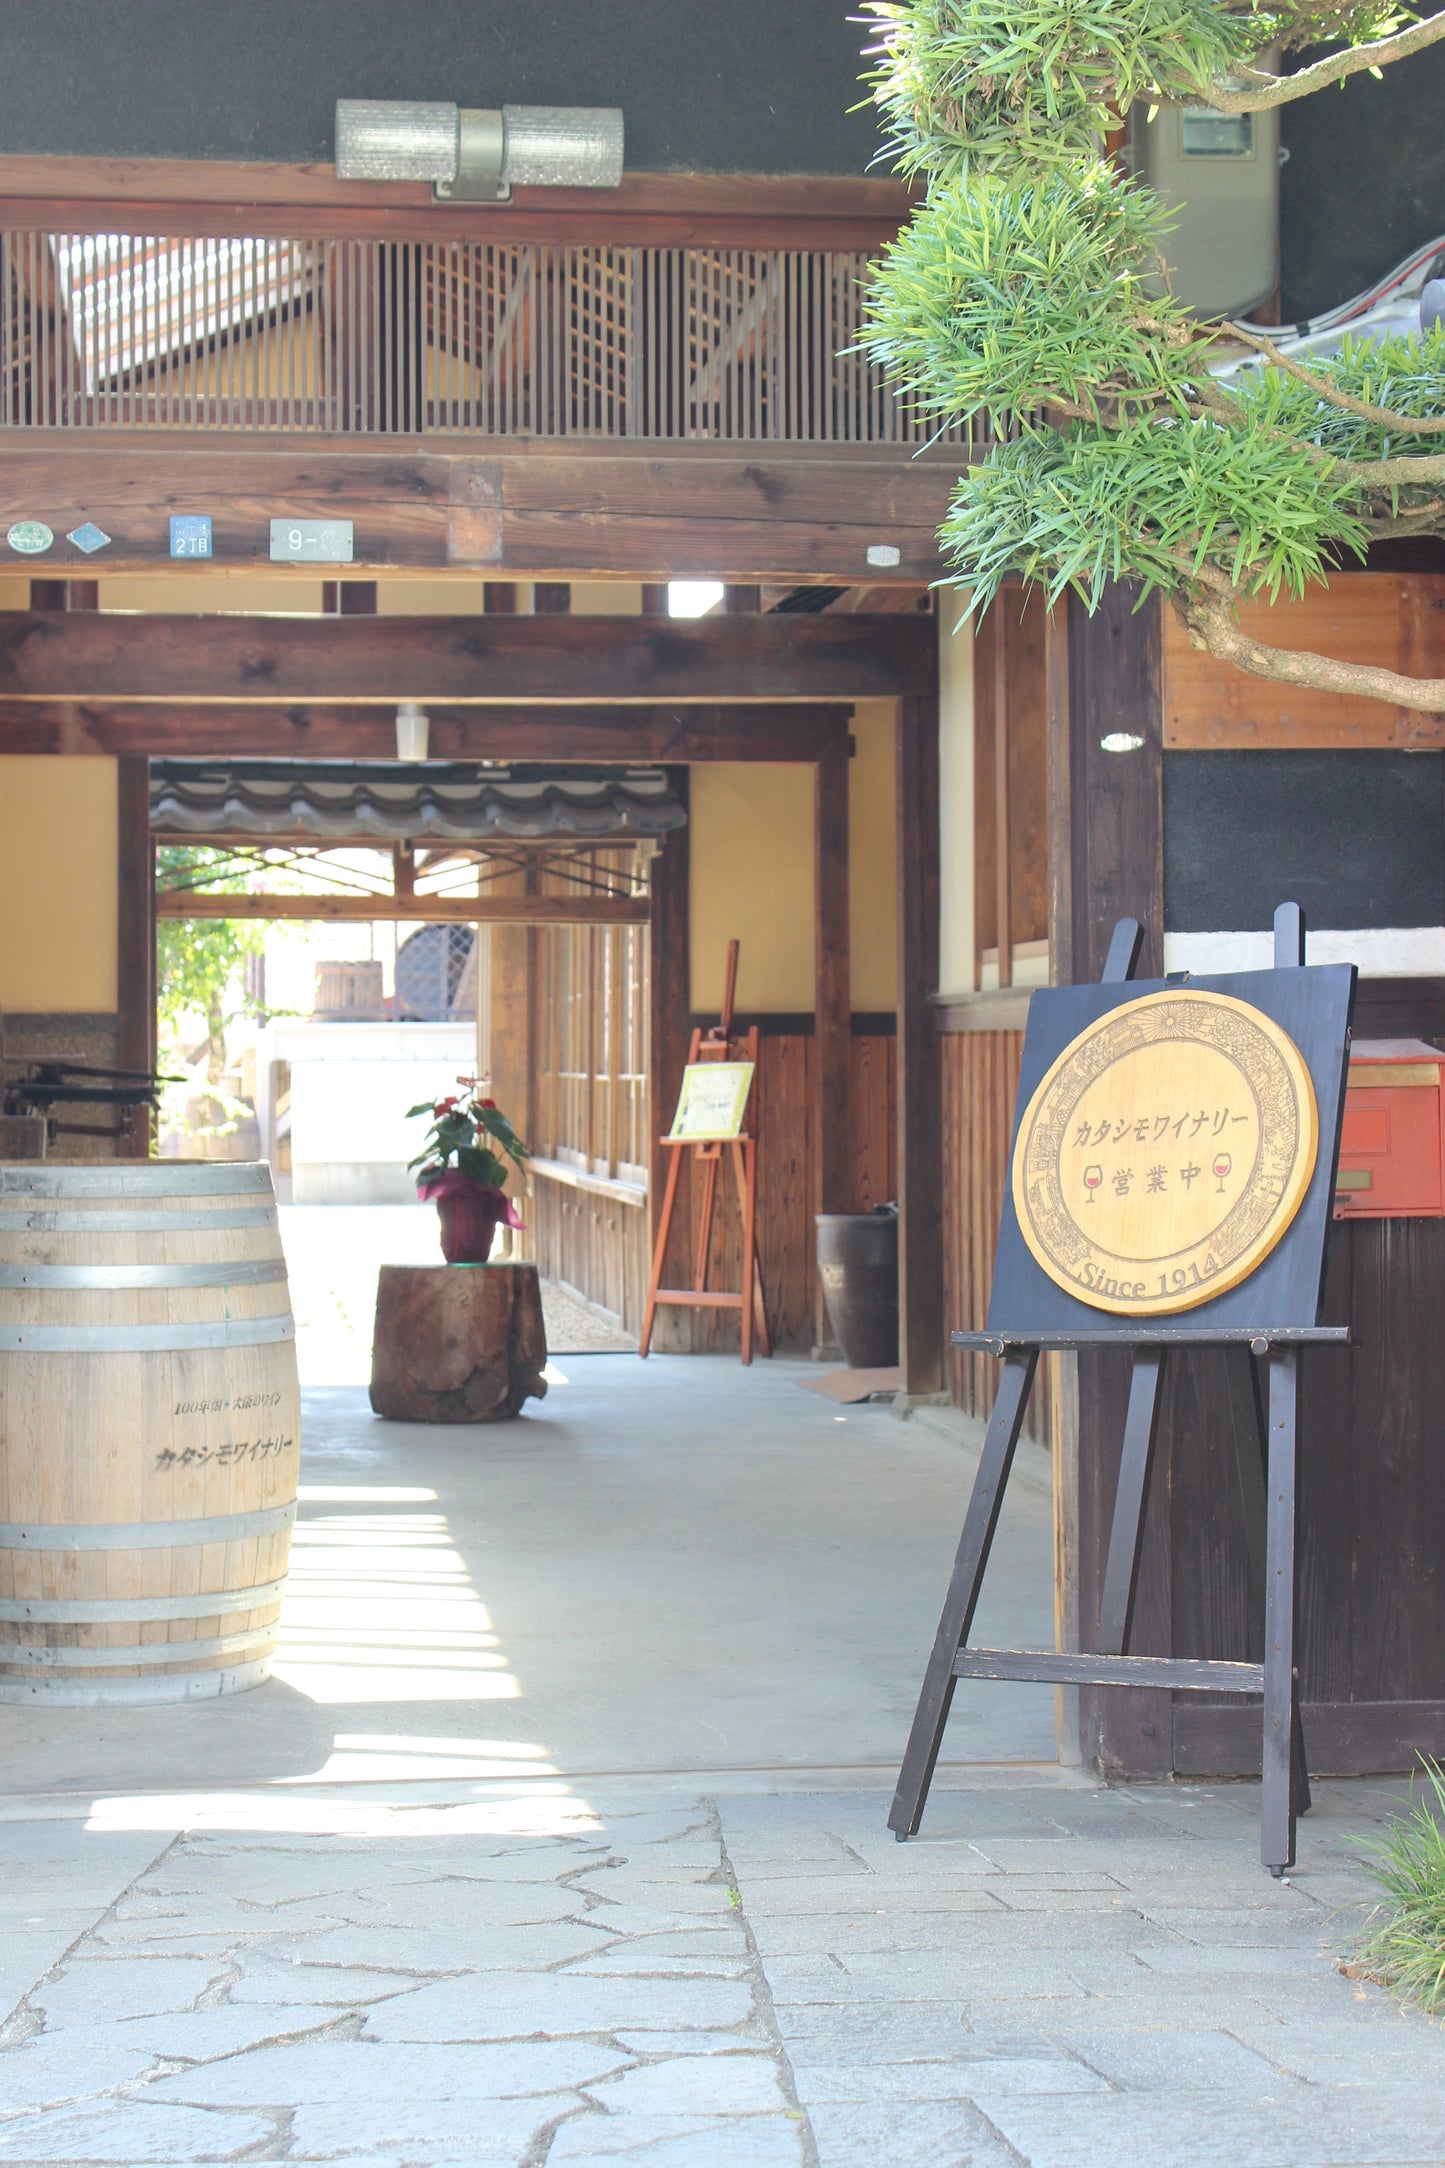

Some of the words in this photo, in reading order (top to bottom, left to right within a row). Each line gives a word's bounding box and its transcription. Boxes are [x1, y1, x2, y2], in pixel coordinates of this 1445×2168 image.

[176, 537, 208, 553] 2丁目
[1072, 1107, 1249, 1147] カタシモワイナリー
[1112, 1161, 1202, 1197] 営業中
[1077, 1262, 1147, 1298] Since
[1157, 1252, 1220, 1296] 1914
[155, 1433, 293, 1471] カタシモワイナリー
